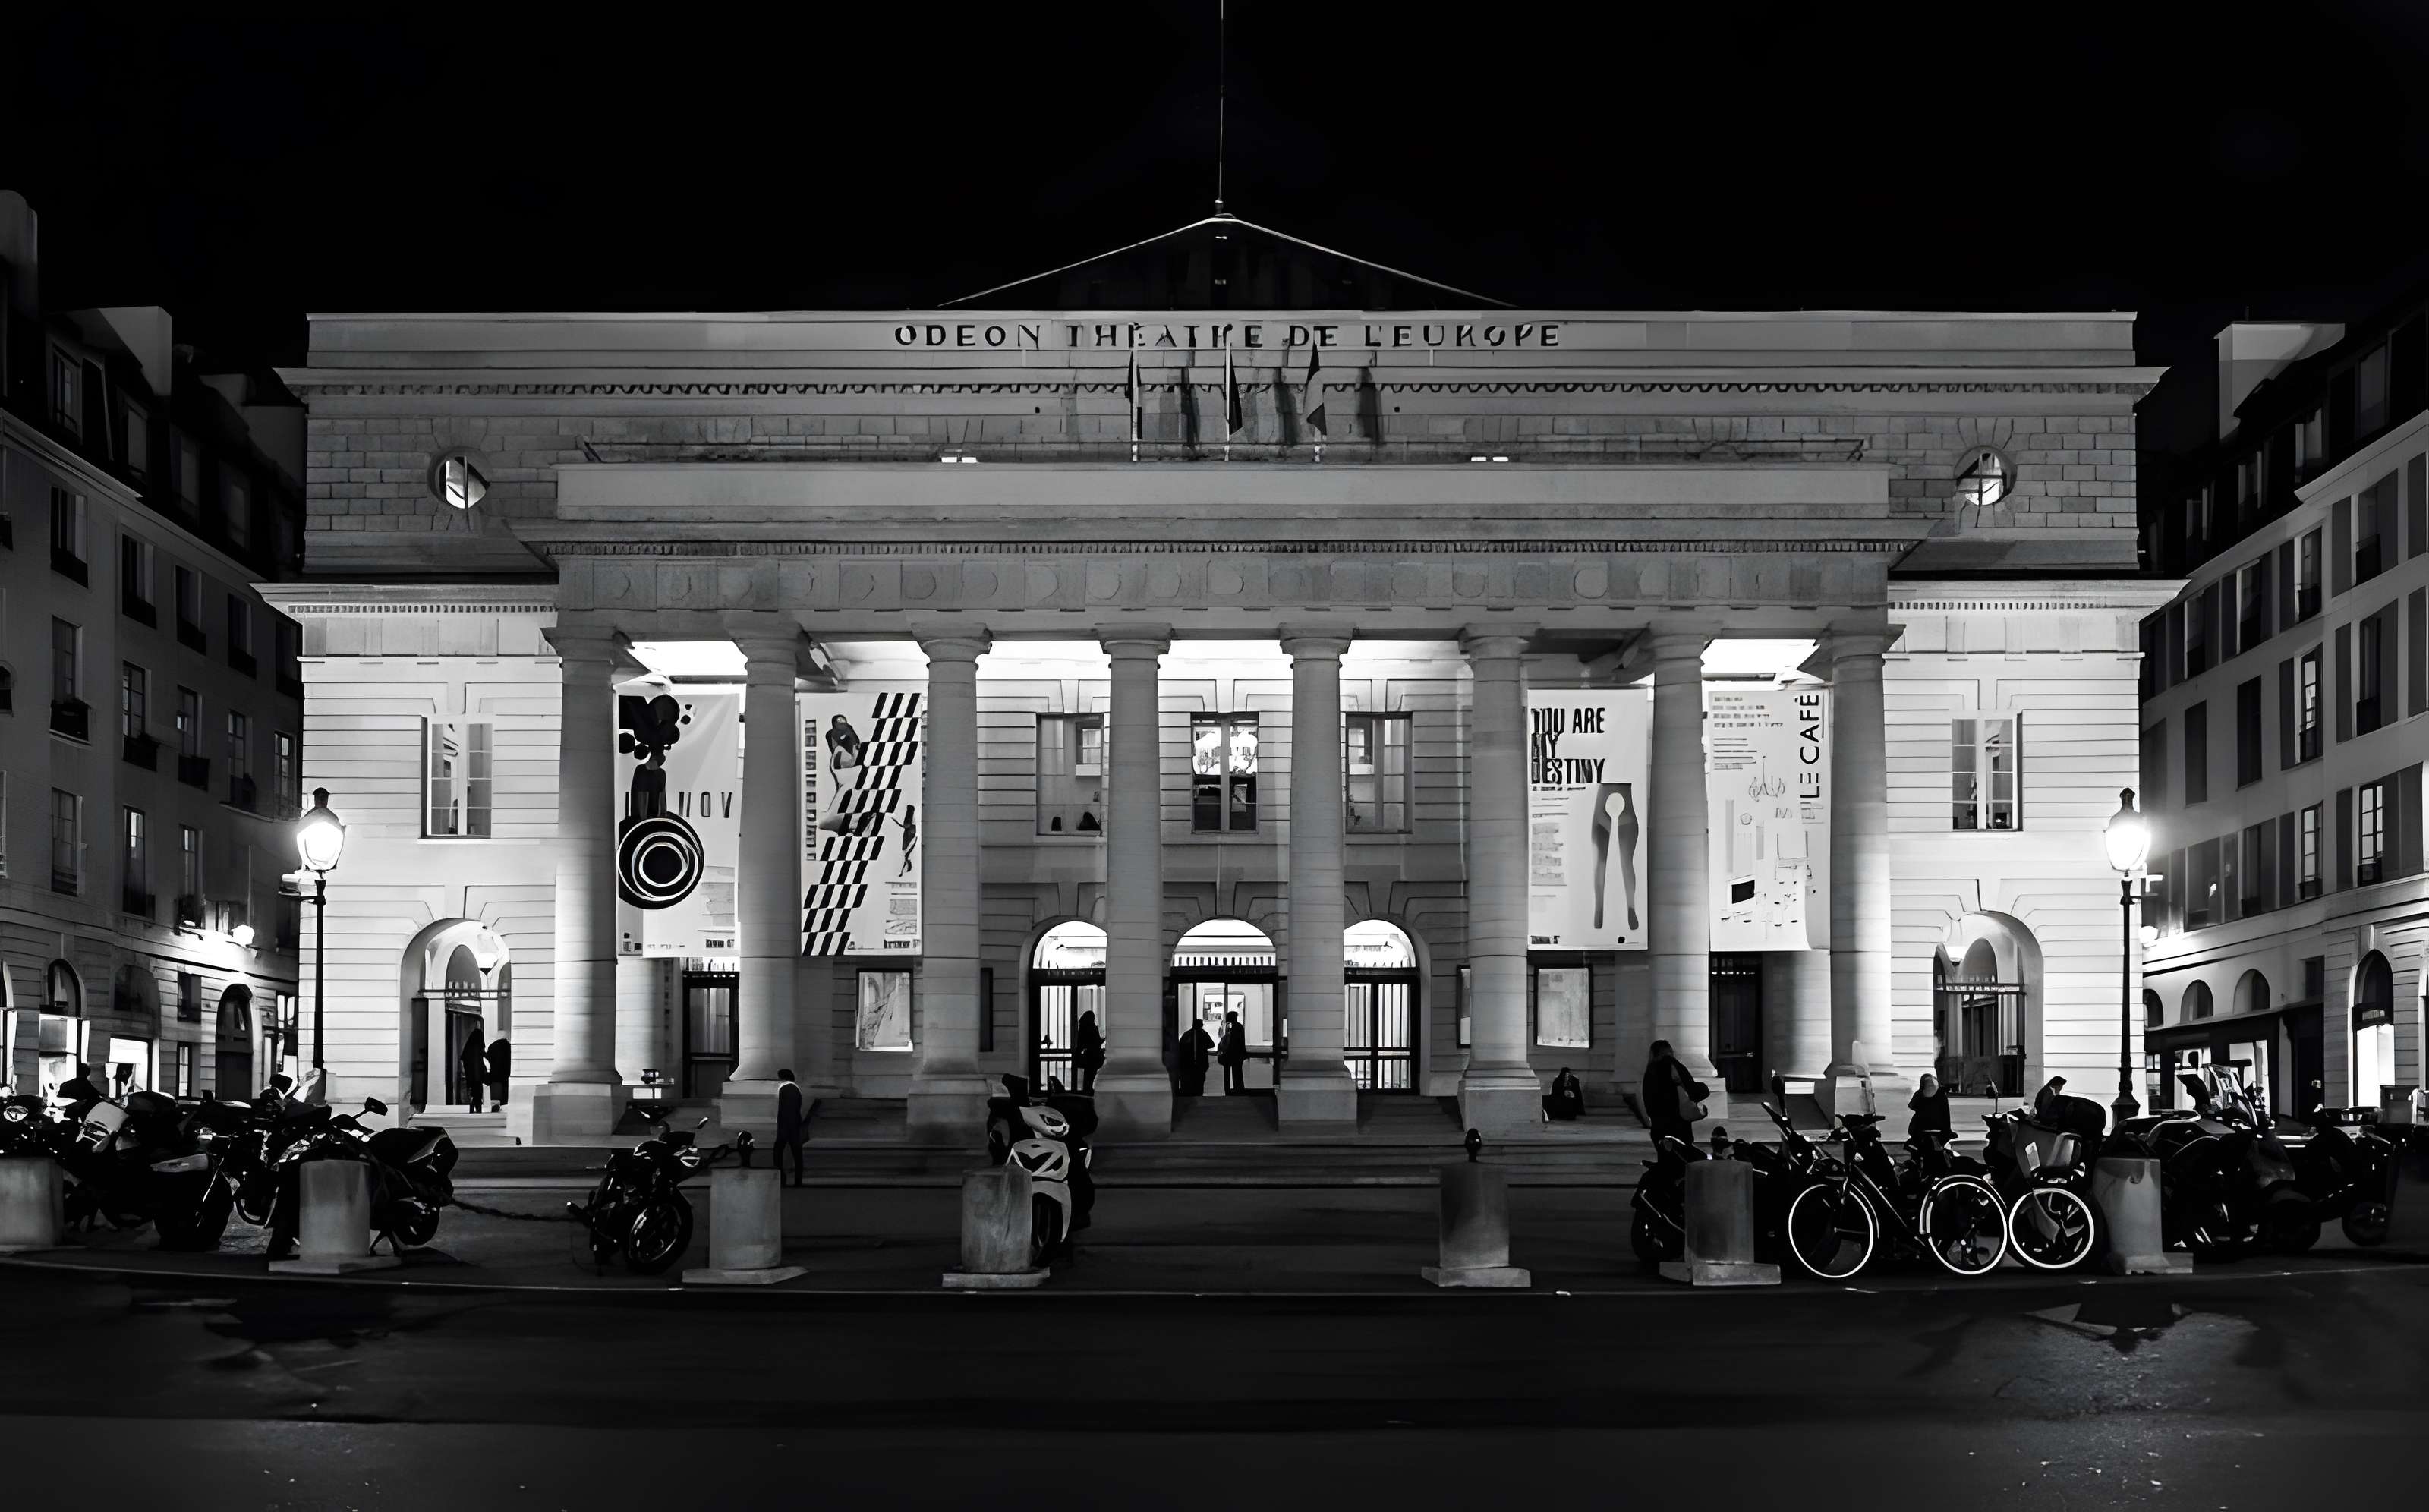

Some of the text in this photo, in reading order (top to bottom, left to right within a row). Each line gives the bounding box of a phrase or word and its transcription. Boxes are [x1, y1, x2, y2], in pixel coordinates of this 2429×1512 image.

[894, 324, 1040, 351] ODEON
[1288, 324, 1338, 347] DE
[1572, 707, 1605, 734] ARE
[1531, 758, 1605, 784] DESTINY
[1800, 773, 1821, 799] LE
